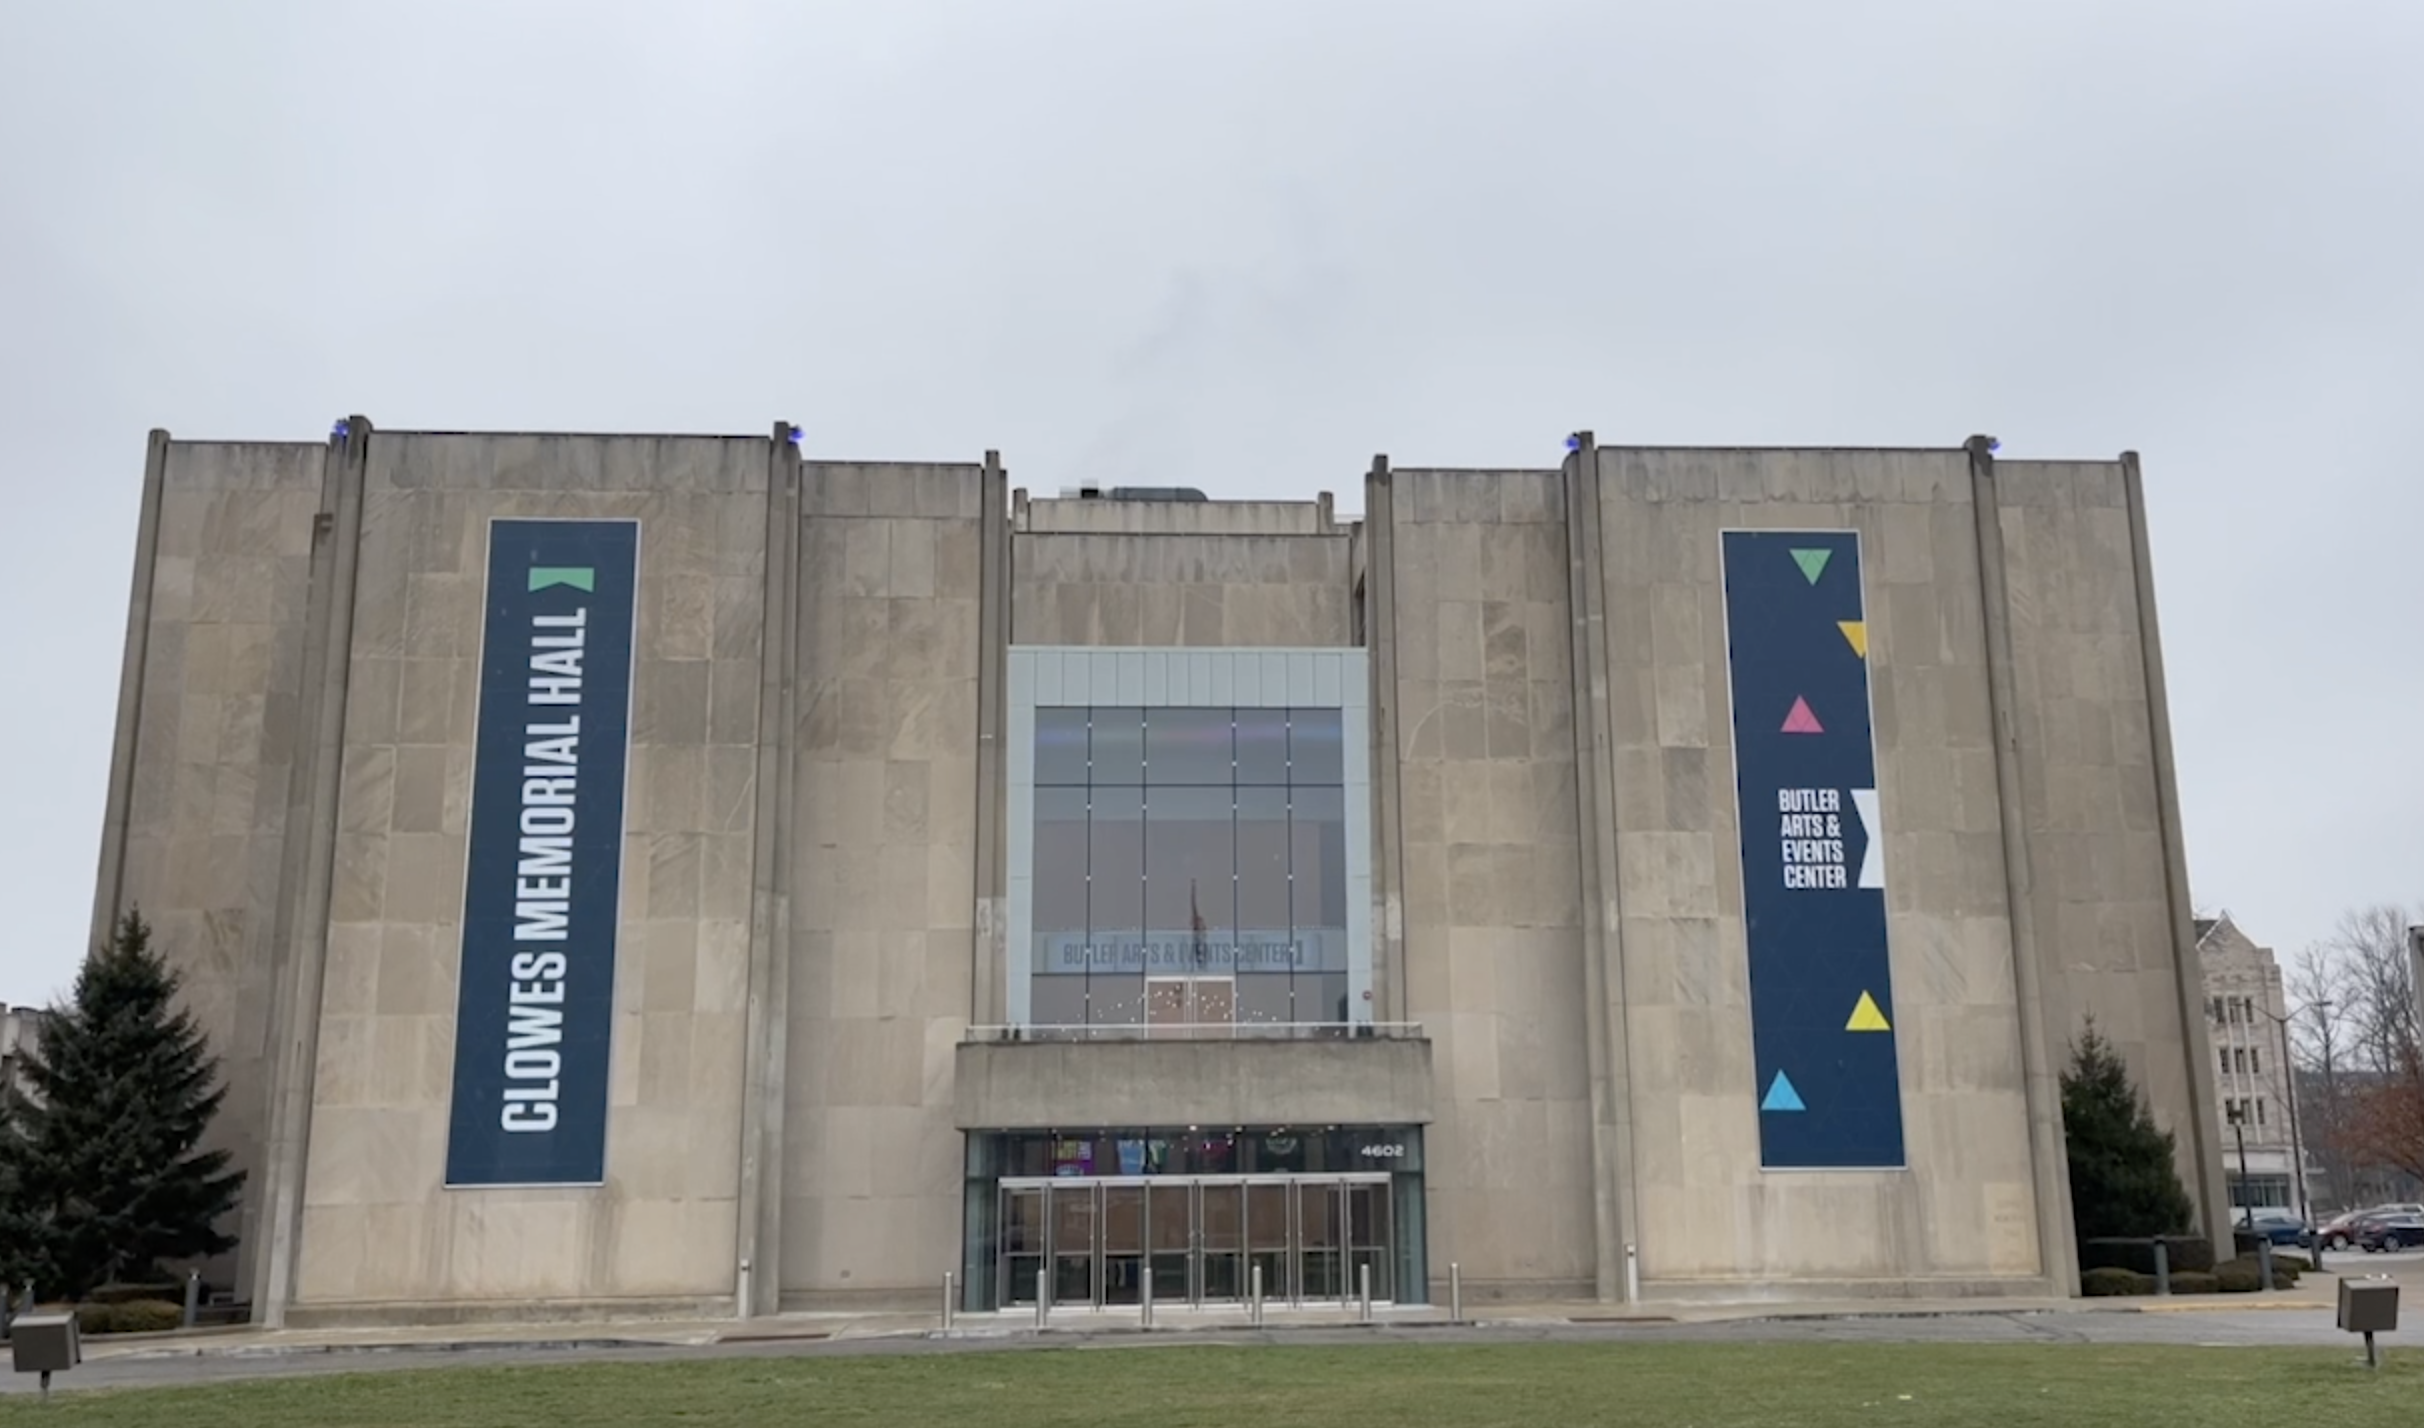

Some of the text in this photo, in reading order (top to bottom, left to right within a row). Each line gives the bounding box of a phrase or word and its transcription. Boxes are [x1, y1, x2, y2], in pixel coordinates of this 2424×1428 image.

[1778, 789, 1840, 812] BUTLER
[1781, 814, 1842, 838] ARTS &
[1782, 839, 1844, 863] EVENTS
[501, 607, 587, 1132] CLOWES MEMORIAL HALL
[1784, 864, 1847, 888] CENTER
[1063, 943, 1117, 965] BULER
[1121, 943, 1160, 964] ARS
[1163, 943, 1175, 964] &
[1361, 1144, 1404, 1157] 4602
